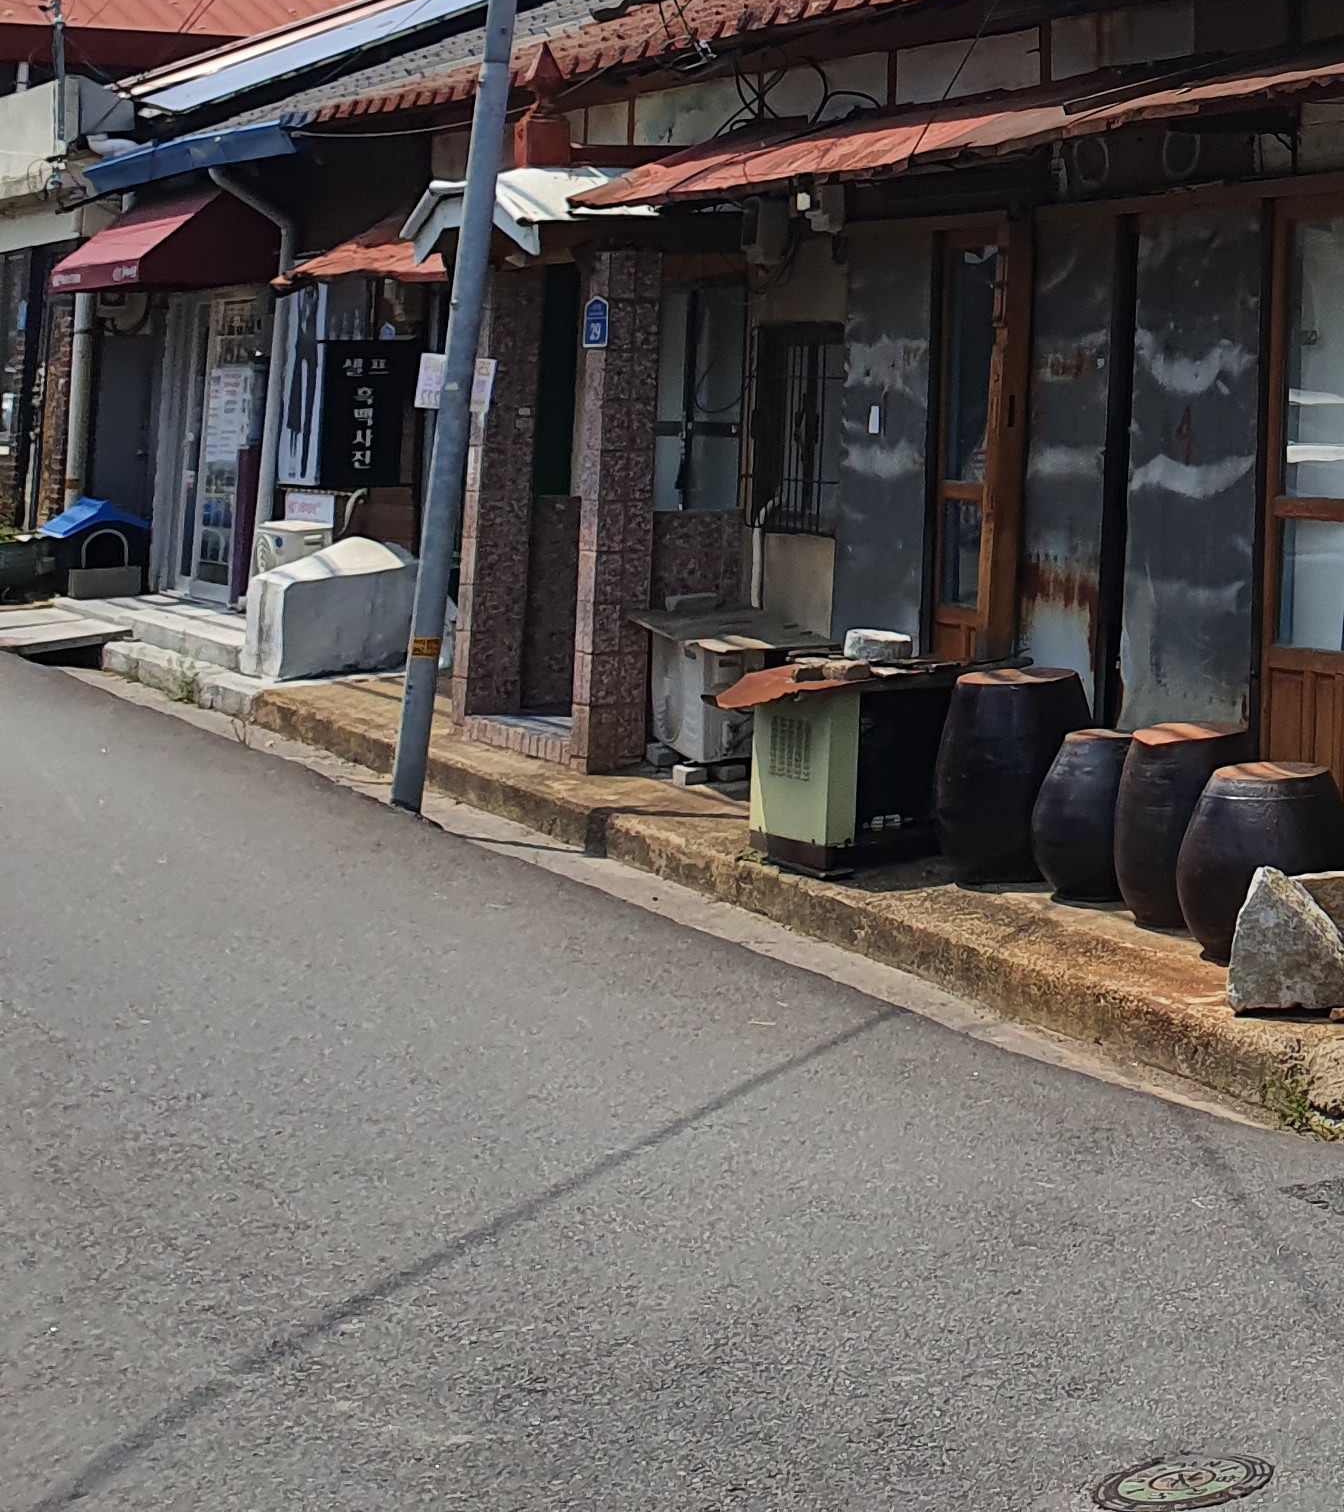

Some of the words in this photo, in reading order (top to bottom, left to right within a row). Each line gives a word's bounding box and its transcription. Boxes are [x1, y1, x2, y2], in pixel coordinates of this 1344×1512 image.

[589, 322, 601, 341] 29
[342, 357, 390, 377] 셀프
[351, 386, 375, 469] 흑백사진
